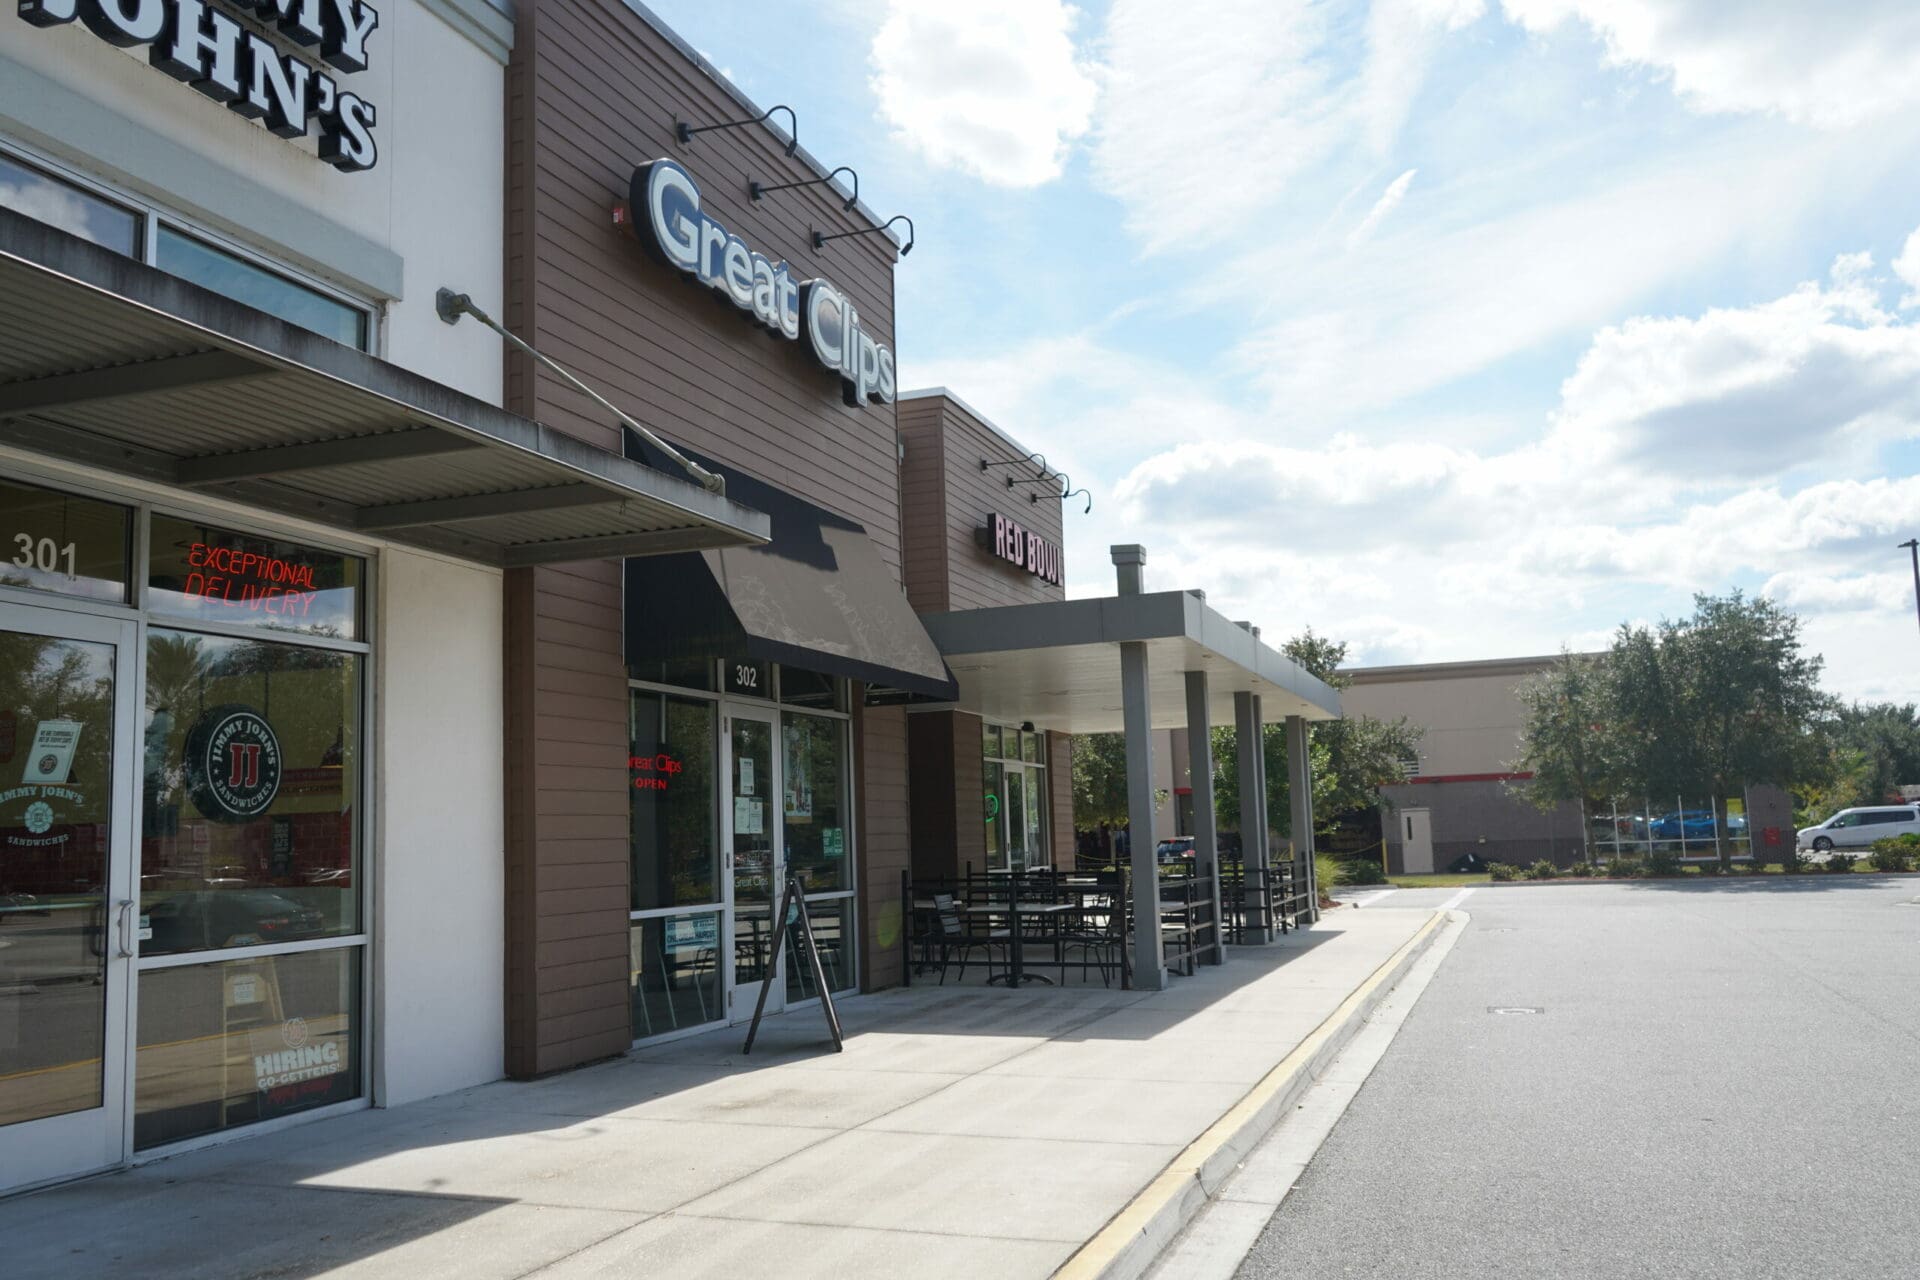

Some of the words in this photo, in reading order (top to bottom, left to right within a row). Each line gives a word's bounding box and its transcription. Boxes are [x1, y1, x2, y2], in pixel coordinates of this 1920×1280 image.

[19, 0, 378, 172] OHN'S
[631, 158, 799, 340] Great
[800, 278, 897, 408] Clips
[13, 533, 77, 580] 301
[189, 543, 318, 590] EXCEPTIONAL
[989, 513, 1024, 568] RED
[1026, 531, 1064, 588] BOWL
[184, 573, 317, 617] DELIVERY
[736, 665, 757, 688] 302
[212, 720, 243, 763] JIMMY
[246, 720, 276, 765] JOHN'S
[229, 743, 261, 788] JJ
[629, 756, 653, 771] reat
[656, 753, 682, 777] Clips
[635, 777, 667, 791] OPEN
[41, 786, 85, 804] JOHN'S
[216, 780, 273, 808] SANDWICHES
[8, 833, 70, 847] SANDWICHES
[255, 1041, 339, 1077] HIRING
[258, 1063, 342, 1089] GO-GETTERS!
